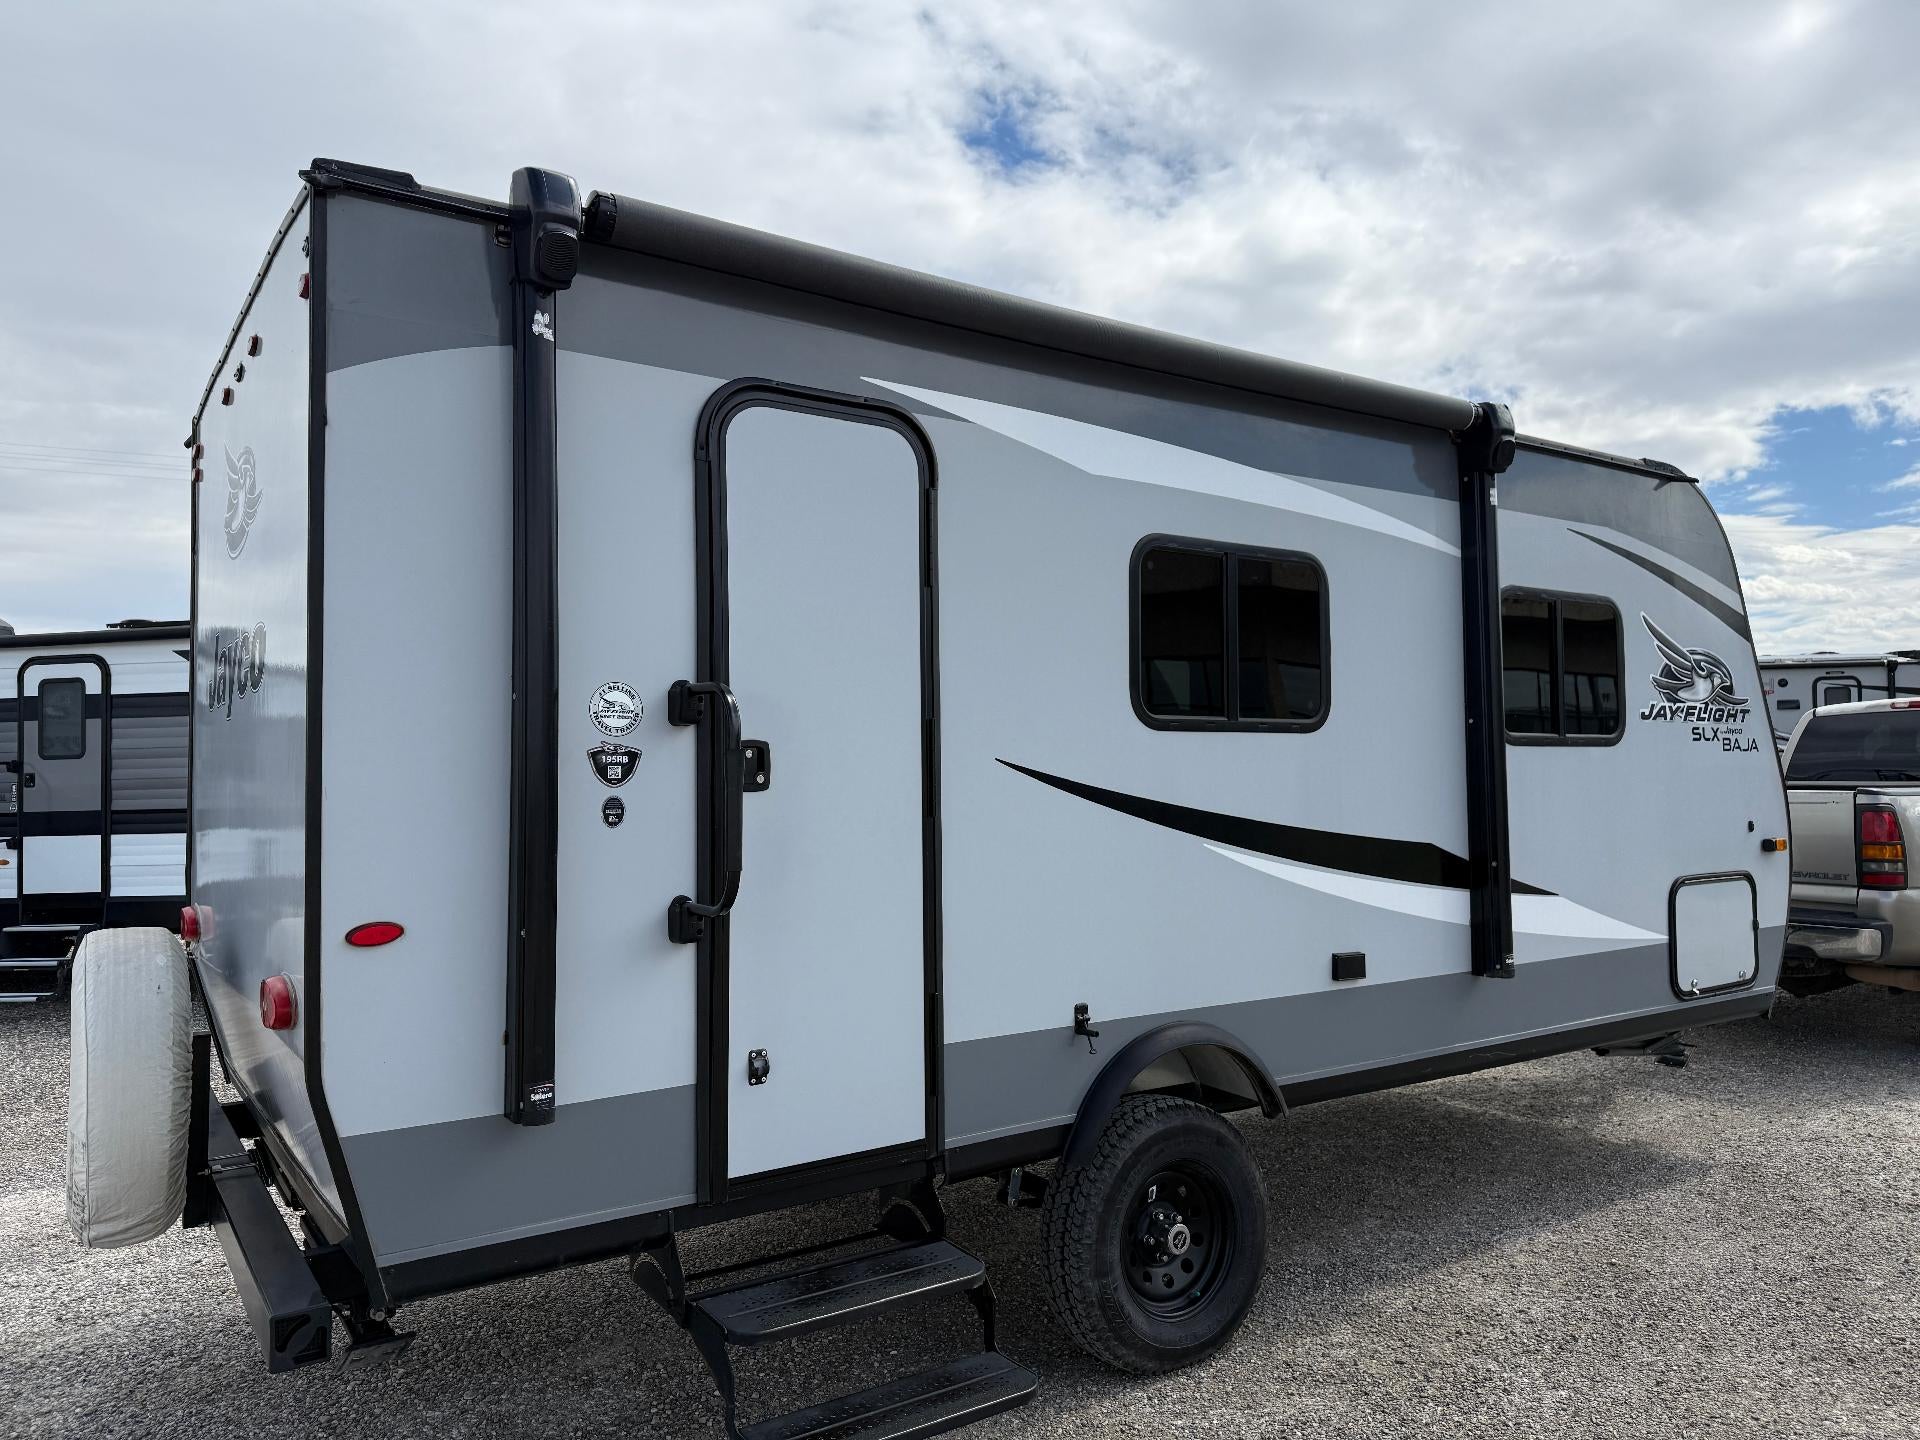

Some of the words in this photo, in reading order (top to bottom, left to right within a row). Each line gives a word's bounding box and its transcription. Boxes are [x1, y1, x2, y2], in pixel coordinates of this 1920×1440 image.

[207, 621, 266, 721] Jayco
[1691, 726, 1721, 742] SLX
[1722, 737, 1760, 752] BAJA
[601, 755, 629, 764] 195RB
[1792, 870, 1850, 881] EVROLET
